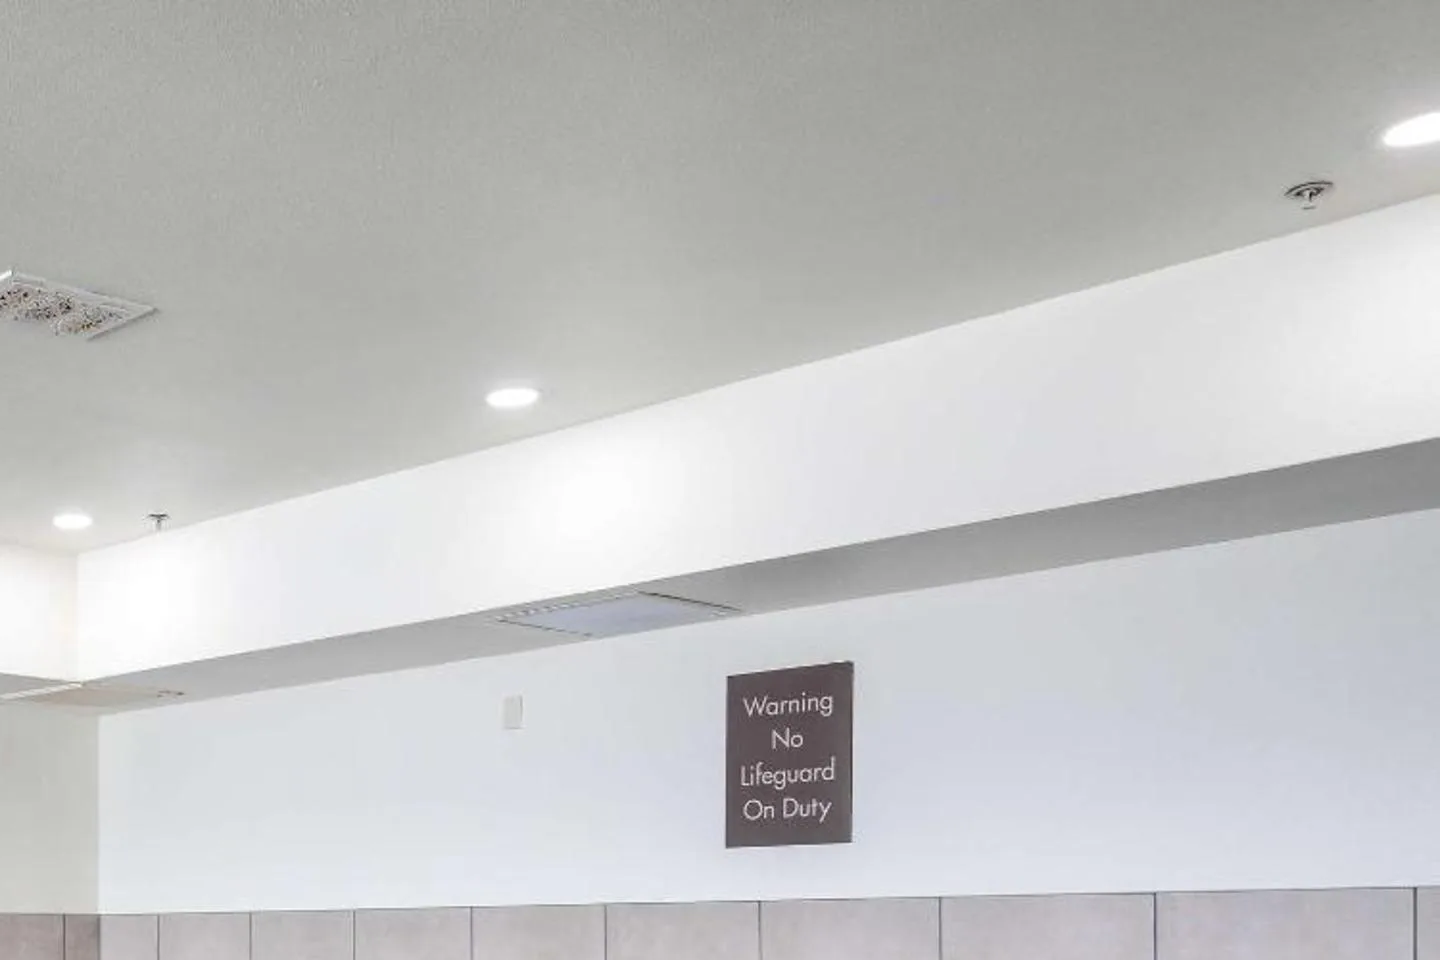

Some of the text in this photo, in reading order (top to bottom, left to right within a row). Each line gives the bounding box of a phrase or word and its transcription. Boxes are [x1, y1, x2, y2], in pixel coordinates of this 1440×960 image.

[743, 691, 833, 717] Warning
[771, 727, 804, 749] No
[740, 756, 835, 790] Lifeguard
[743, 798, 832, 823] On Duty
